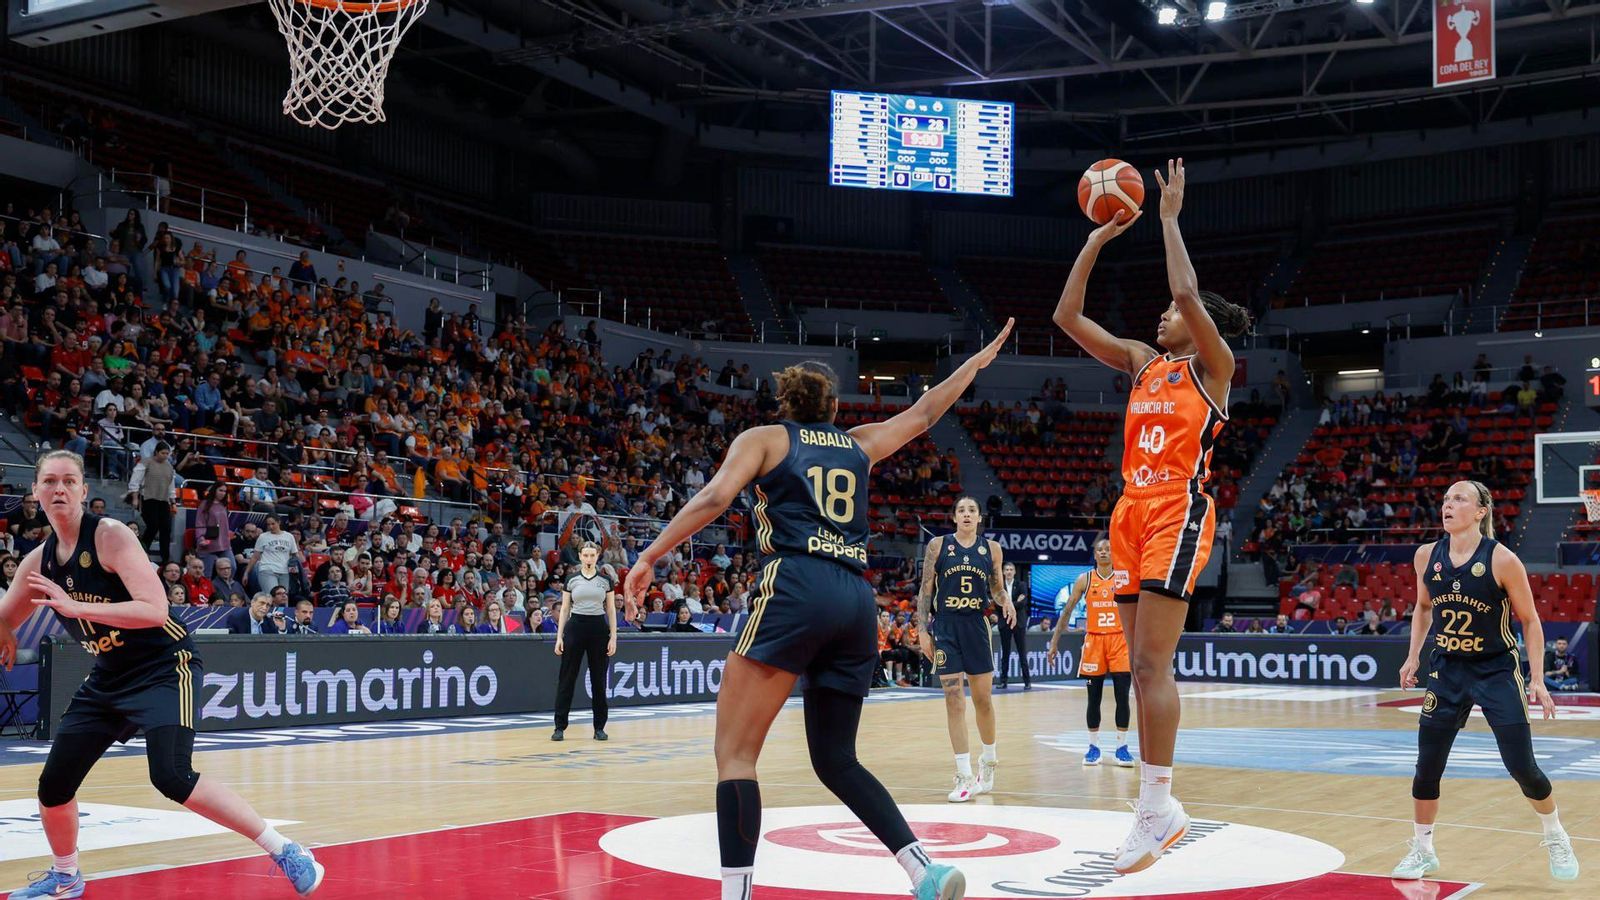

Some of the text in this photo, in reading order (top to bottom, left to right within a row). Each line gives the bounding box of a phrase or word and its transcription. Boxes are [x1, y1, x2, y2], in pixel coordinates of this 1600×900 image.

[1440, 63, 1458, 75] COPA
[1460, 61, 1473, 72] DEL
[1474, 58, 1488, 69] REY
[1130, 402, 1175, 414] VALENCIA BC
[800, 428, 853, 449] SABALLY
[1138, 425, 1165, 454] 40
[807, 466, 857, 523] 18
[808, 536, 867, 564] papara
[960, 576, 973, 594] 5
[1098, 613, 1116, 627] 22
[1441, 609, 1474, 636] 22
[1436, 633, 1485, 652] opet
[1174, 642, 1378, 681] ulmarino
[201, 650, 498, 720] zulmarino
